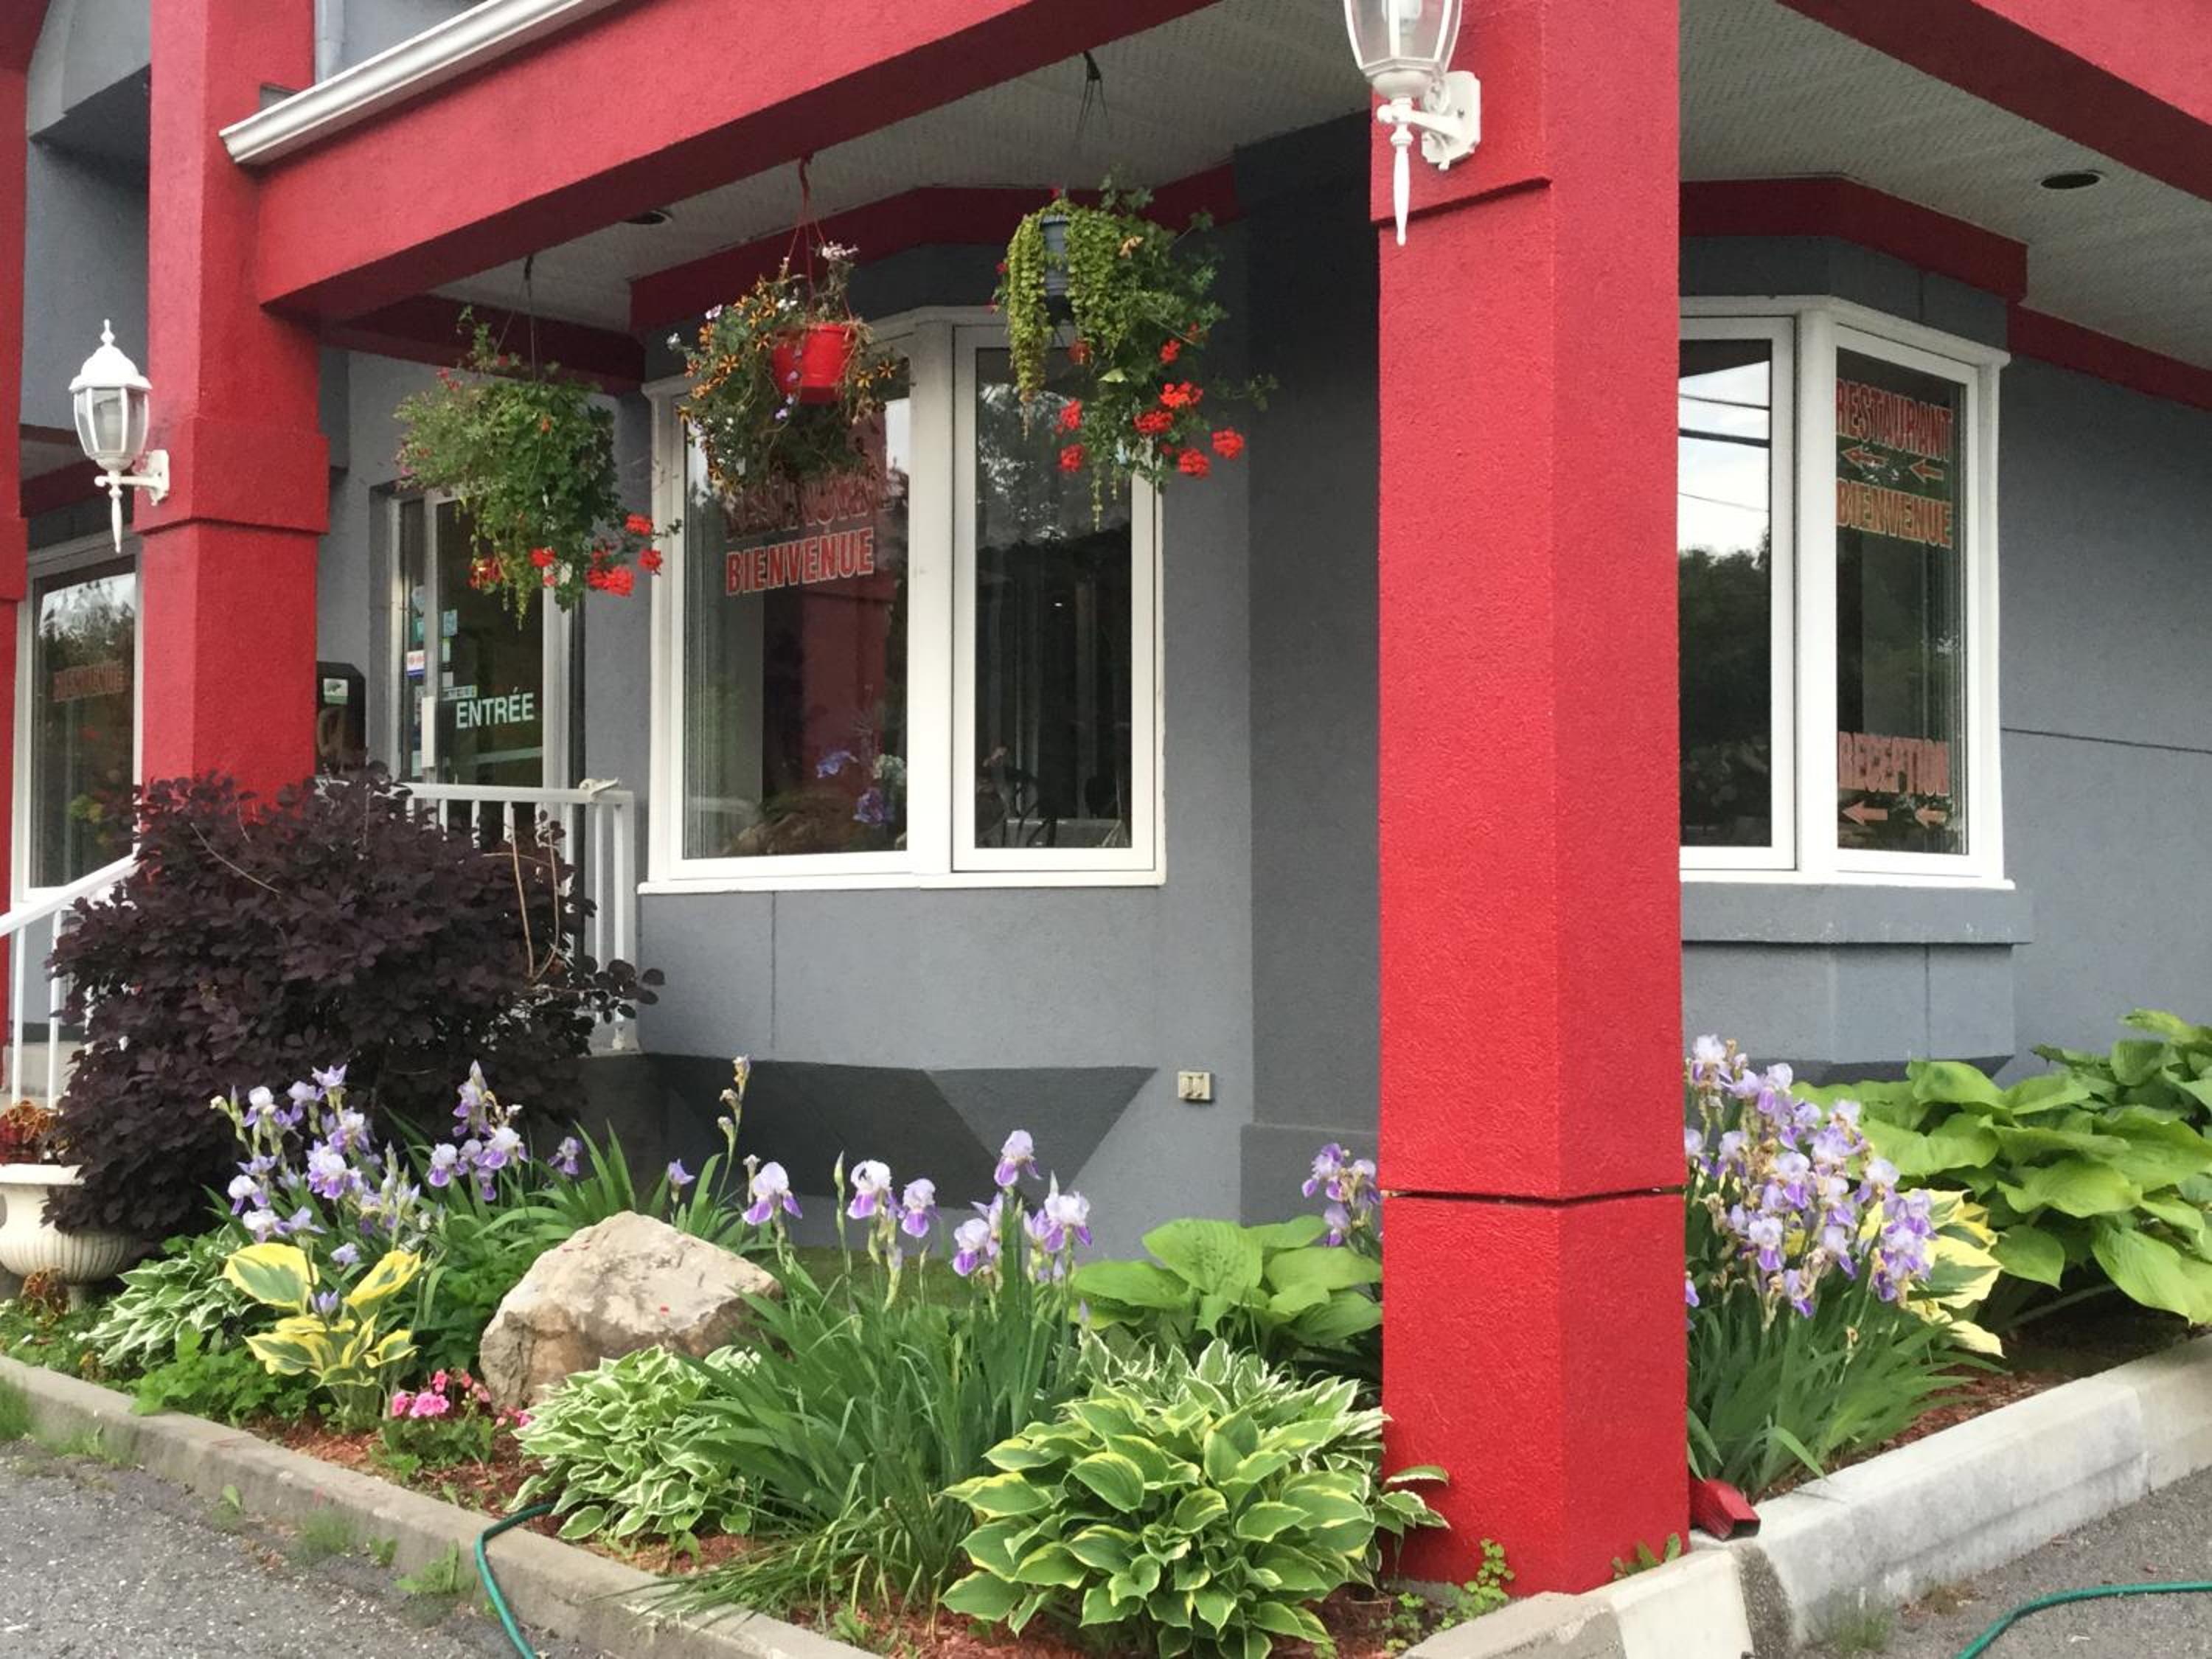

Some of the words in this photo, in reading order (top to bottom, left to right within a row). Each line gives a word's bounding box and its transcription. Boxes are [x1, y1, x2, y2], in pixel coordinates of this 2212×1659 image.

[1836, 378, 1952, 462] RESTAURANT
[1836, 477, 1952, 549] BIENVENUE
[726, 526, 874, 596] BIENVENUE
[456, 686, 535, 728] ENTRÉE
